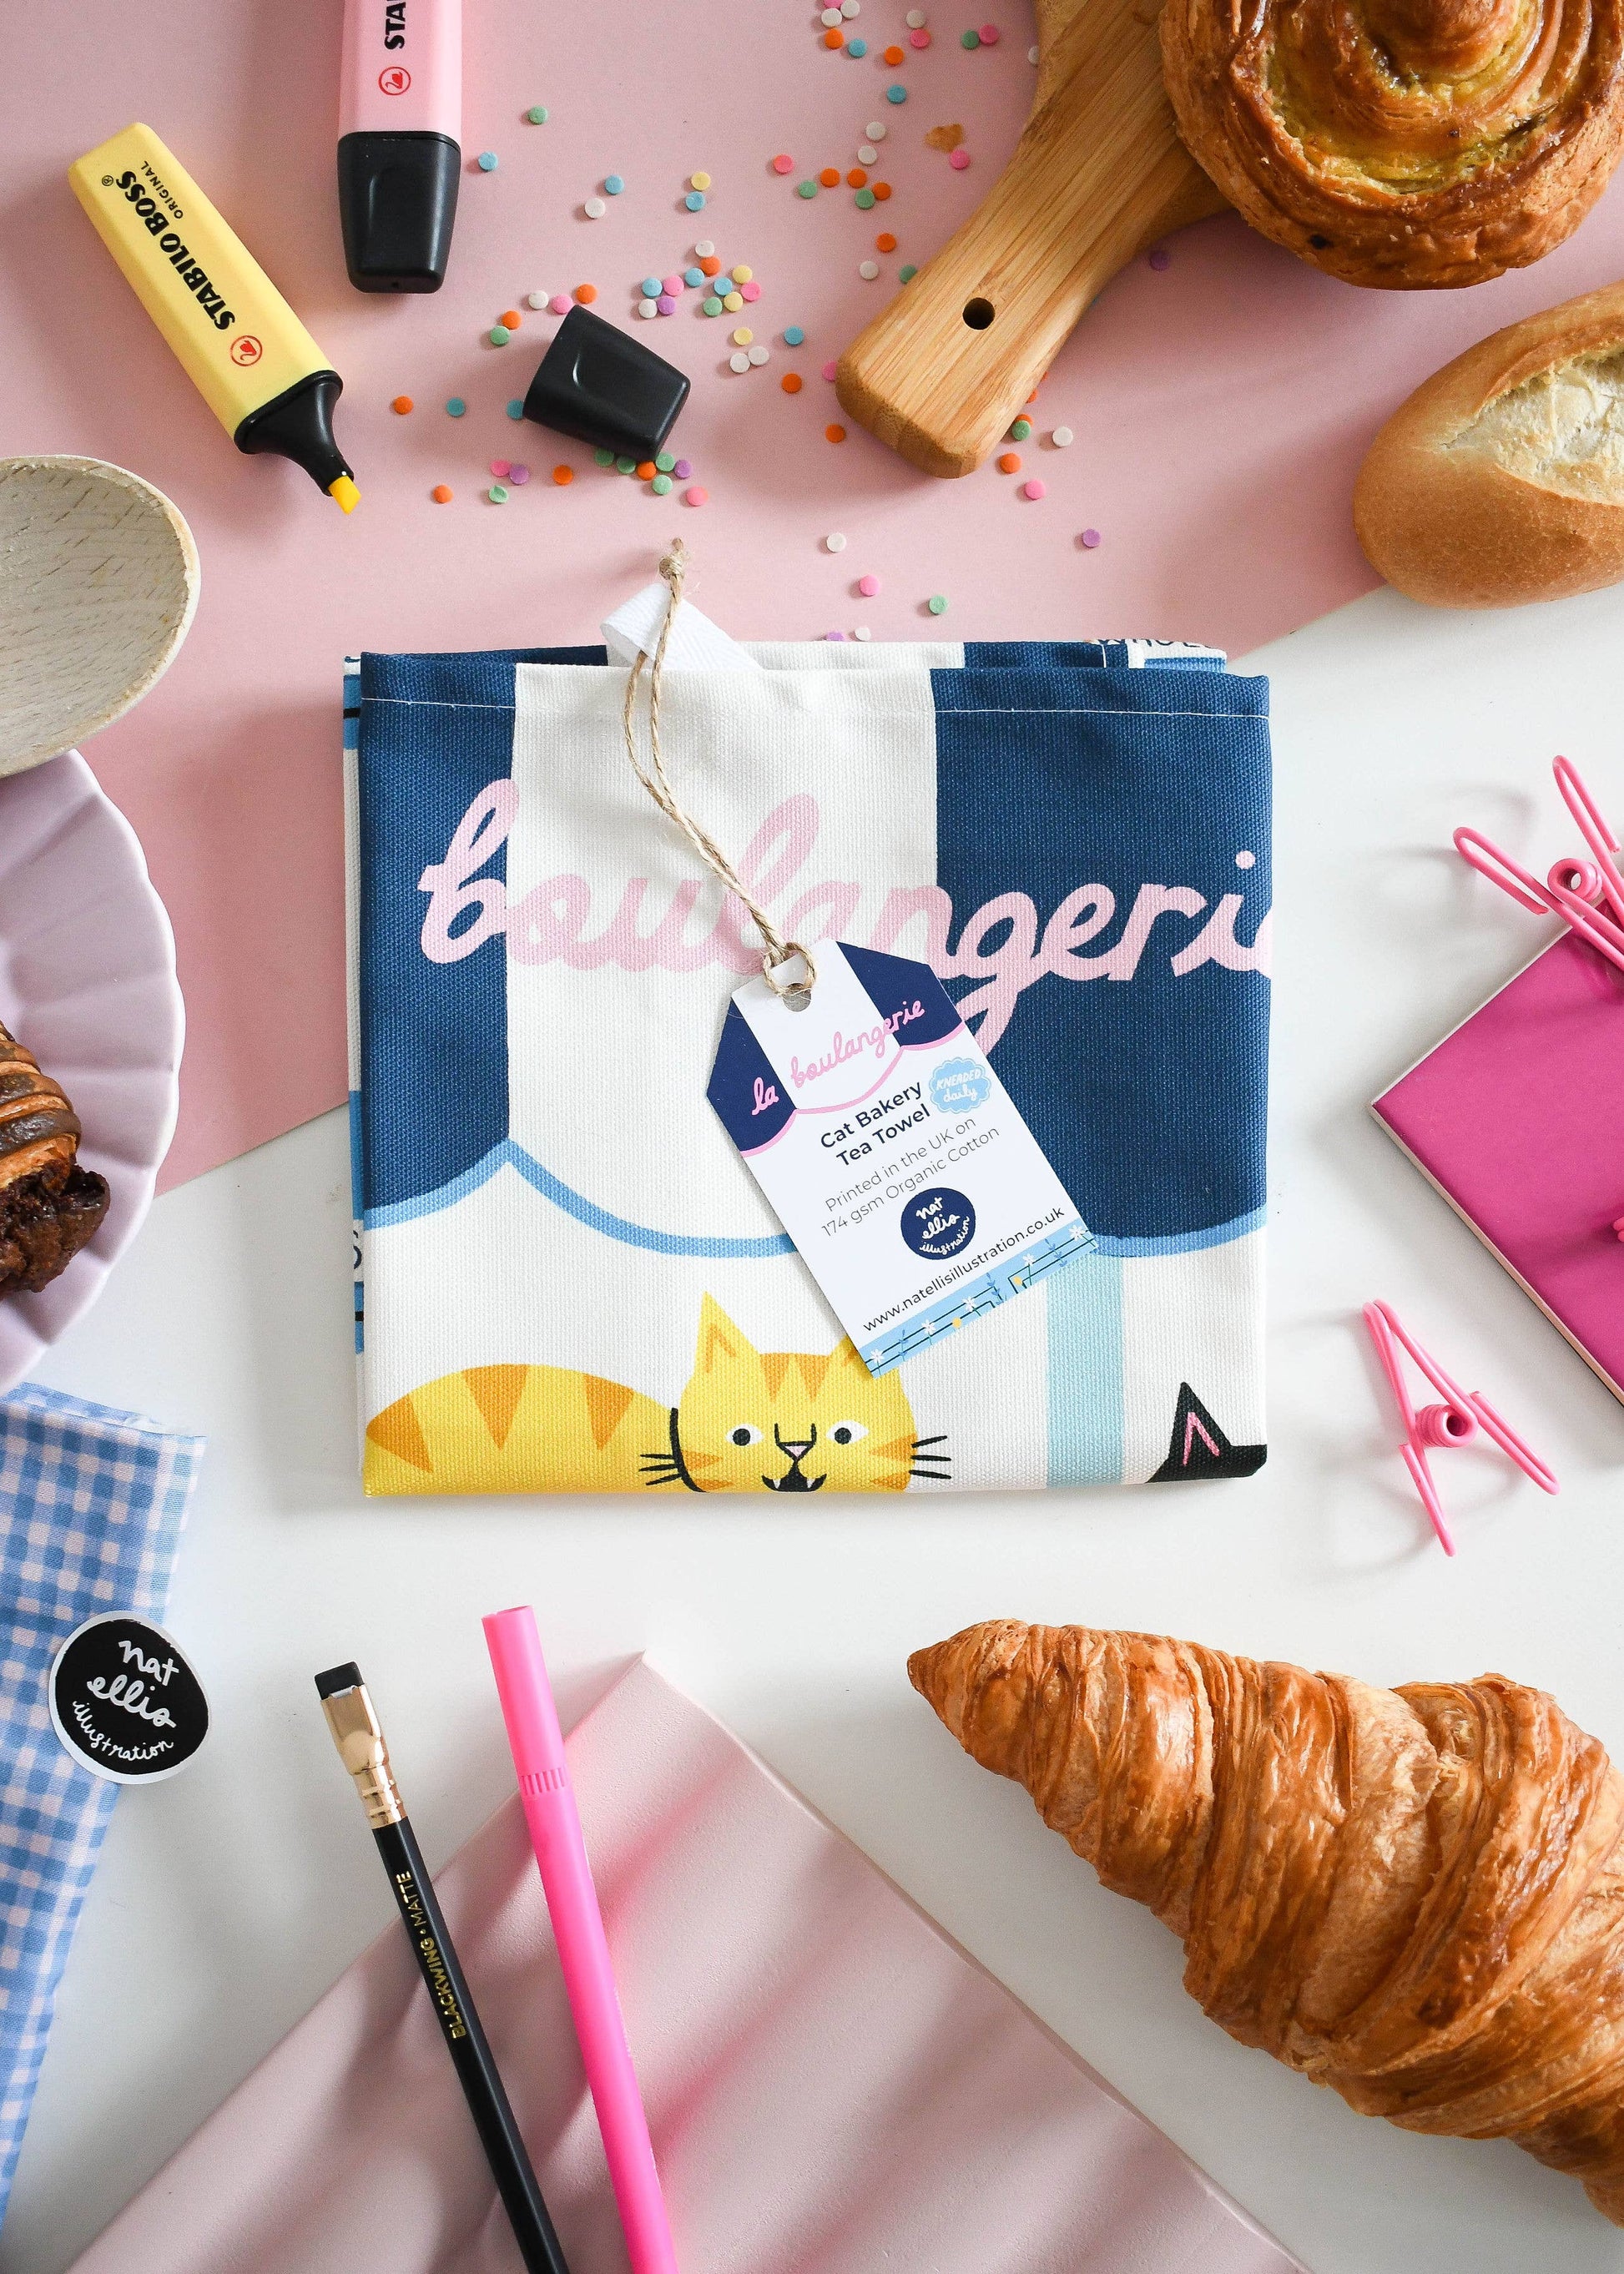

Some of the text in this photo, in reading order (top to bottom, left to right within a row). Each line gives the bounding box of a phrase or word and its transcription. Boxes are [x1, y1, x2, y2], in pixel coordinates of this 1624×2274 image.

[384, 0, 406, 50] STA
[140, 160, 184, 219] ORIGINAL
[159, 233, 235, 330] STABILO
[751, 1000, 925, 1116] la boulangerie
[936, 1068, 981, 1091] KNEADED
[820, 1082, 922, 1148] Cat Bakery
[943, 1083, 977, 1102] daily
[835, 1102, 931, 1166] Tea Towel
[821, 1127, 1000, 1237] 174 gsm Organic Cotton
[825, 1118, 976, 1212] Printed in the UK on
[915, 1197, 943, 1220] nat
[919, 1215, 971, 1255] illustration
[921, 1213, 961, 1239] ellis
[862, 1207, 1066, 1333] www.natellisillustration.co.uk
[118, 1640, 179, 1686] nat
[72, 1700, 174, 1762] illustration
[86, 1674, 177, 1728] ellis
[396, 1870, 467, 2039] BLACKWING MATTE
